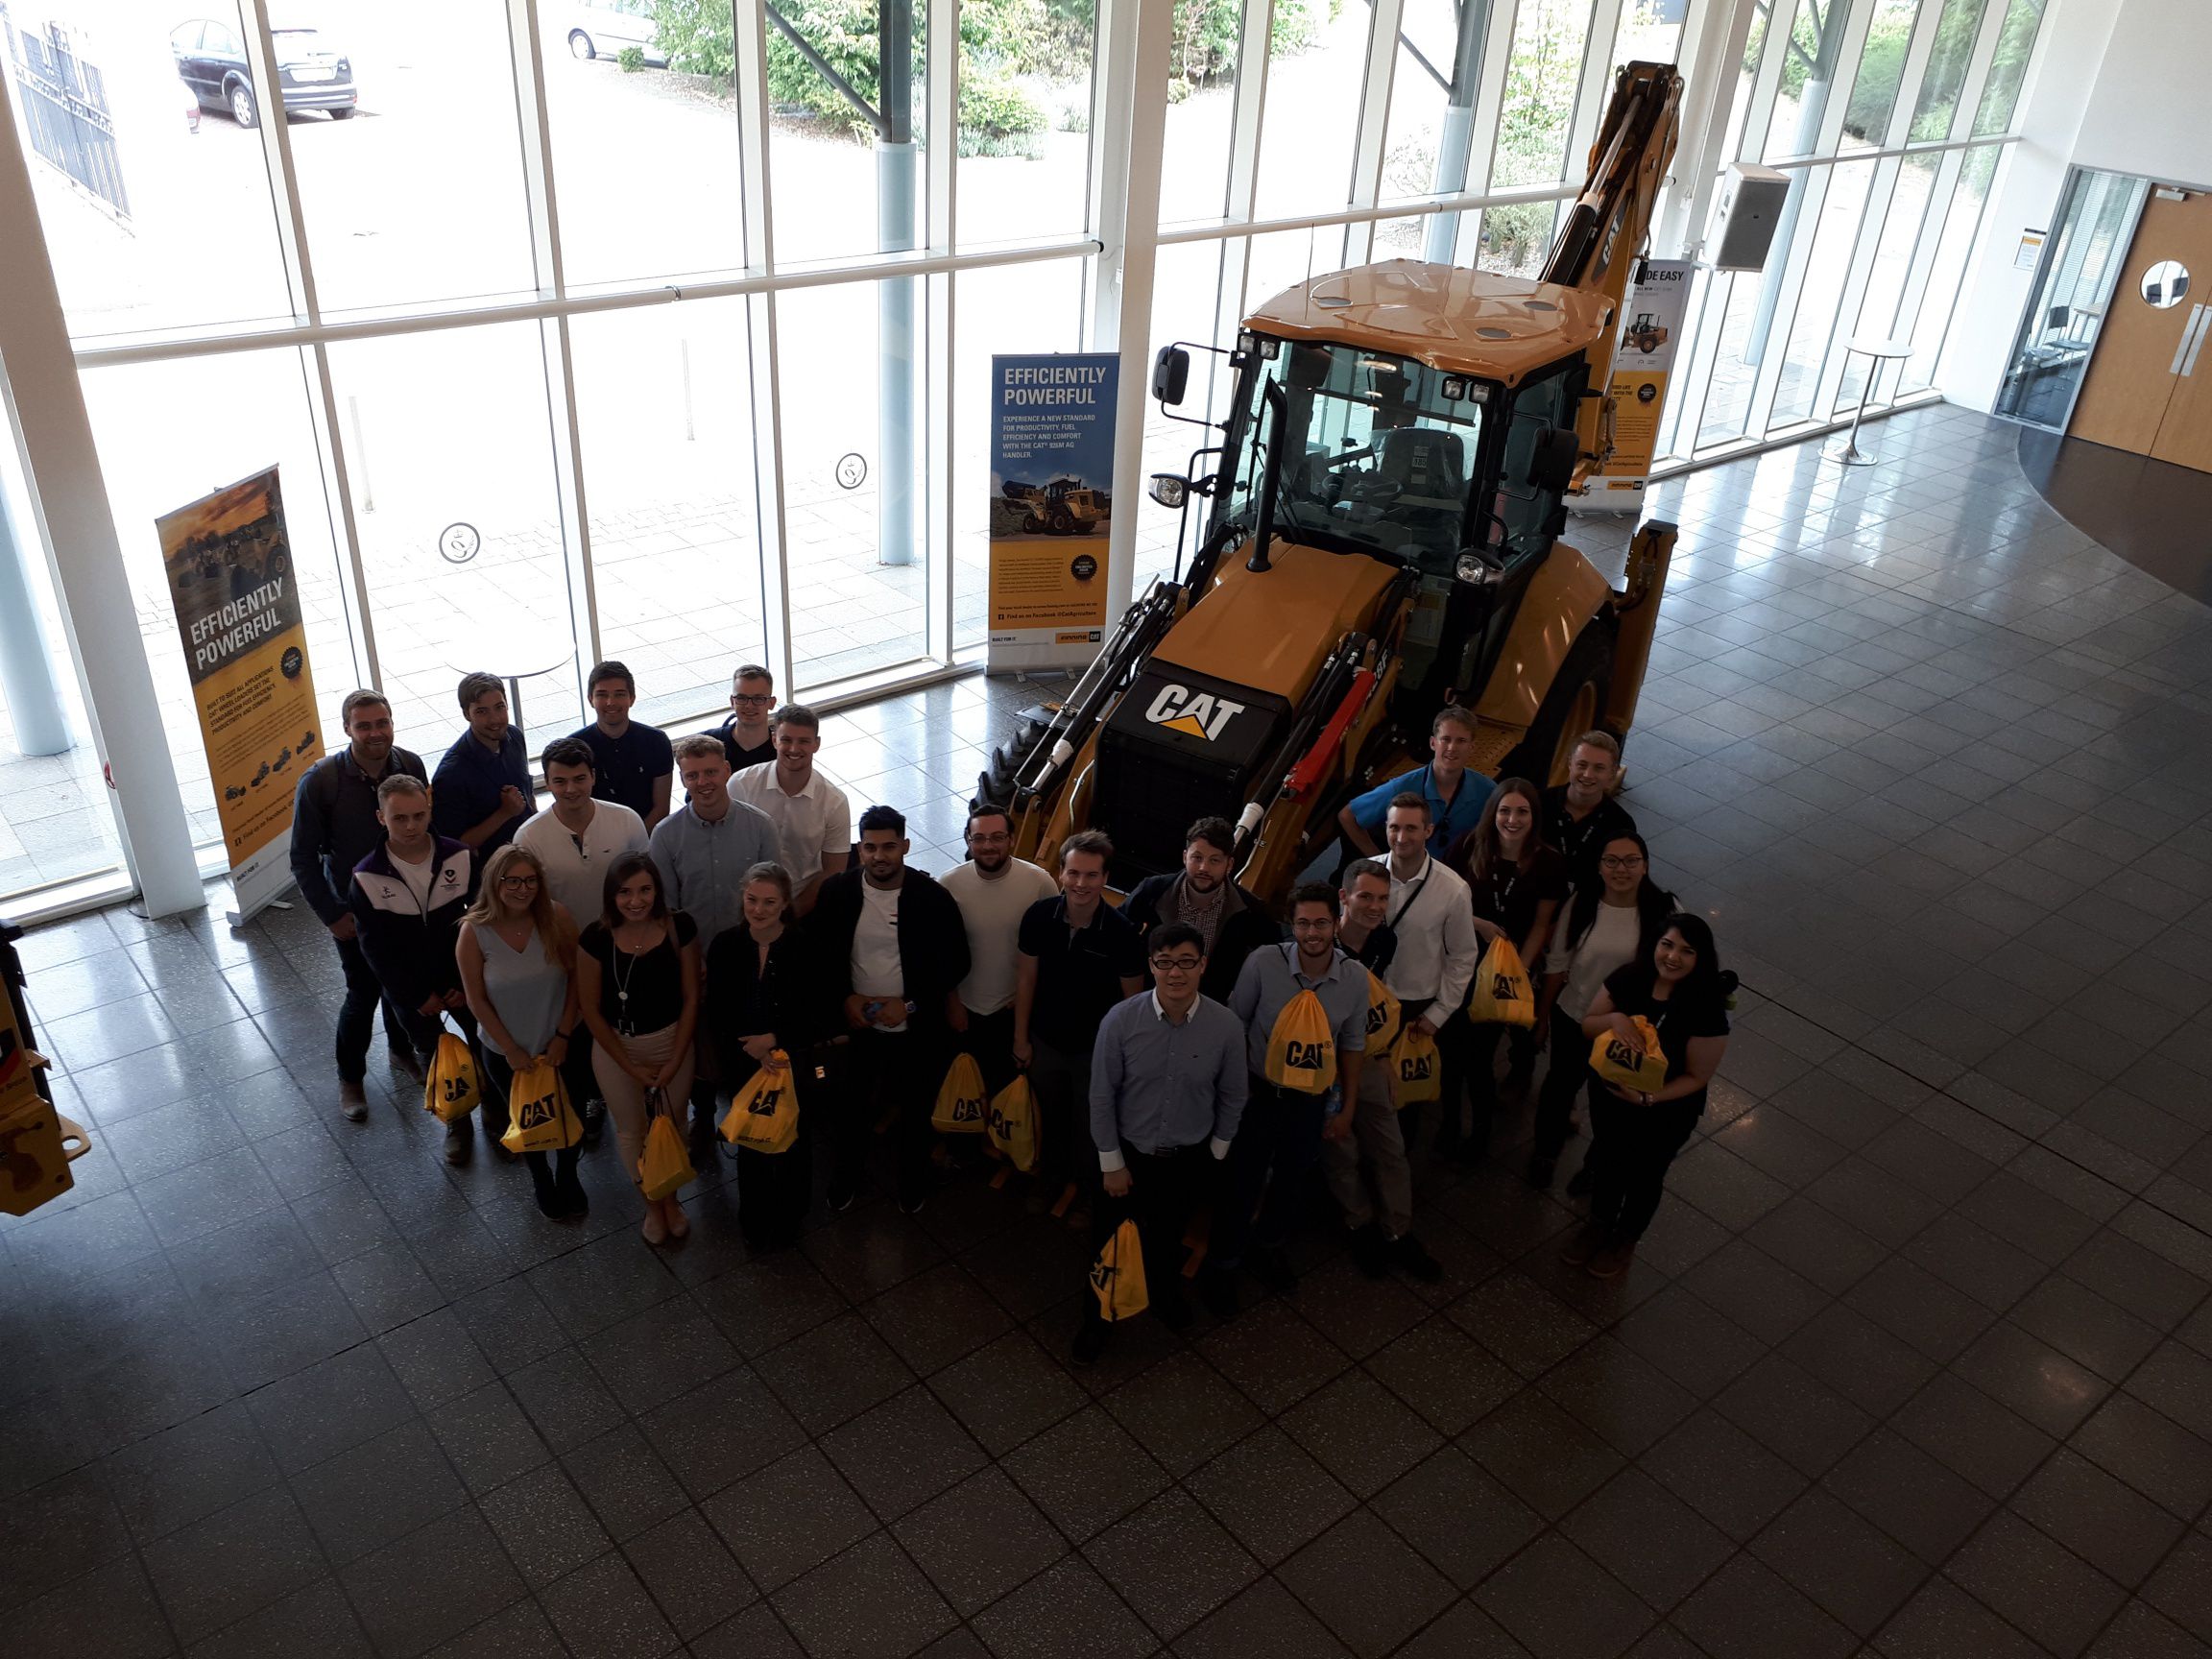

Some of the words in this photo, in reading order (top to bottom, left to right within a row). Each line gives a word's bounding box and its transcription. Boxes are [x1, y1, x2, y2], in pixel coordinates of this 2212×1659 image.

[1602, 215, 1619, 265] CAT
[1660, 271, 1684, 280] EASY
[1005, 367, 1106, 384] EFFICIENTLY
[1004, 388, 1095, 405] POWERFUL
[190, 577, 282, 645] EFFICIENTLY
[196, 607, 281, 670] POWERFUL
[1145, 684, 1246, 741] CAT
[1365, 1000, 1387, 1034] AT
[1286, 1041, 1323, 1070] CAT
[520, 1093, 556, 1130] CAT
